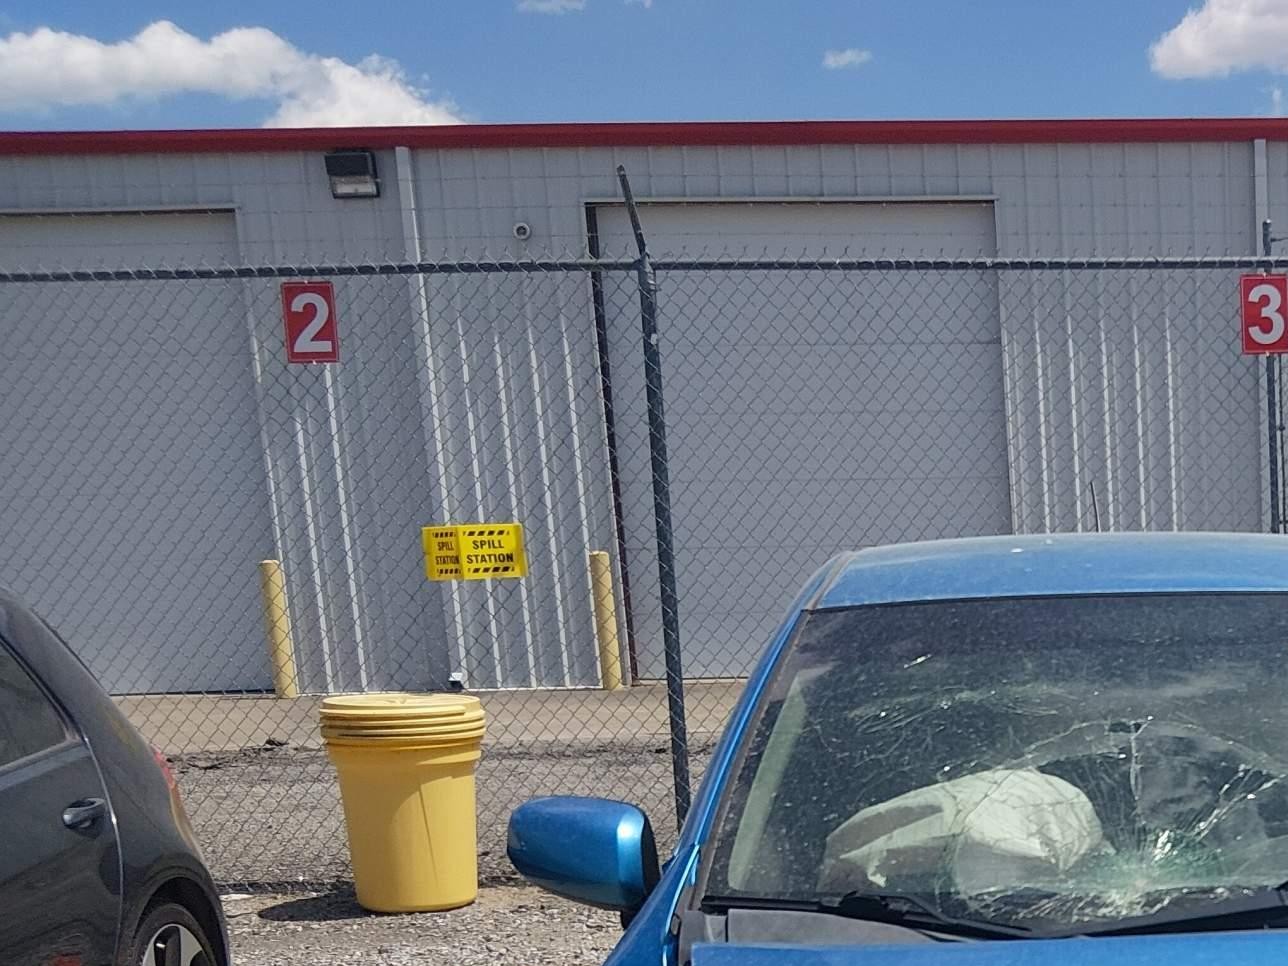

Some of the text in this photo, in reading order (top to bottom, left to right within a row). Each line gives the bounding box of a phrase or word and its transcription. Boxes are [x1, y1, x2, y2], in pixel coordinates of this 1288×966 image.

[1248, 284, 1285, 345] 3
[290, 292, 333, 353] 2
[437, 541, 454, 551] SPILL
[472, 539, 504, 549] SPILL
[435, 555, 460, 565] STATION
[466, 552, 514, 564] STATION
